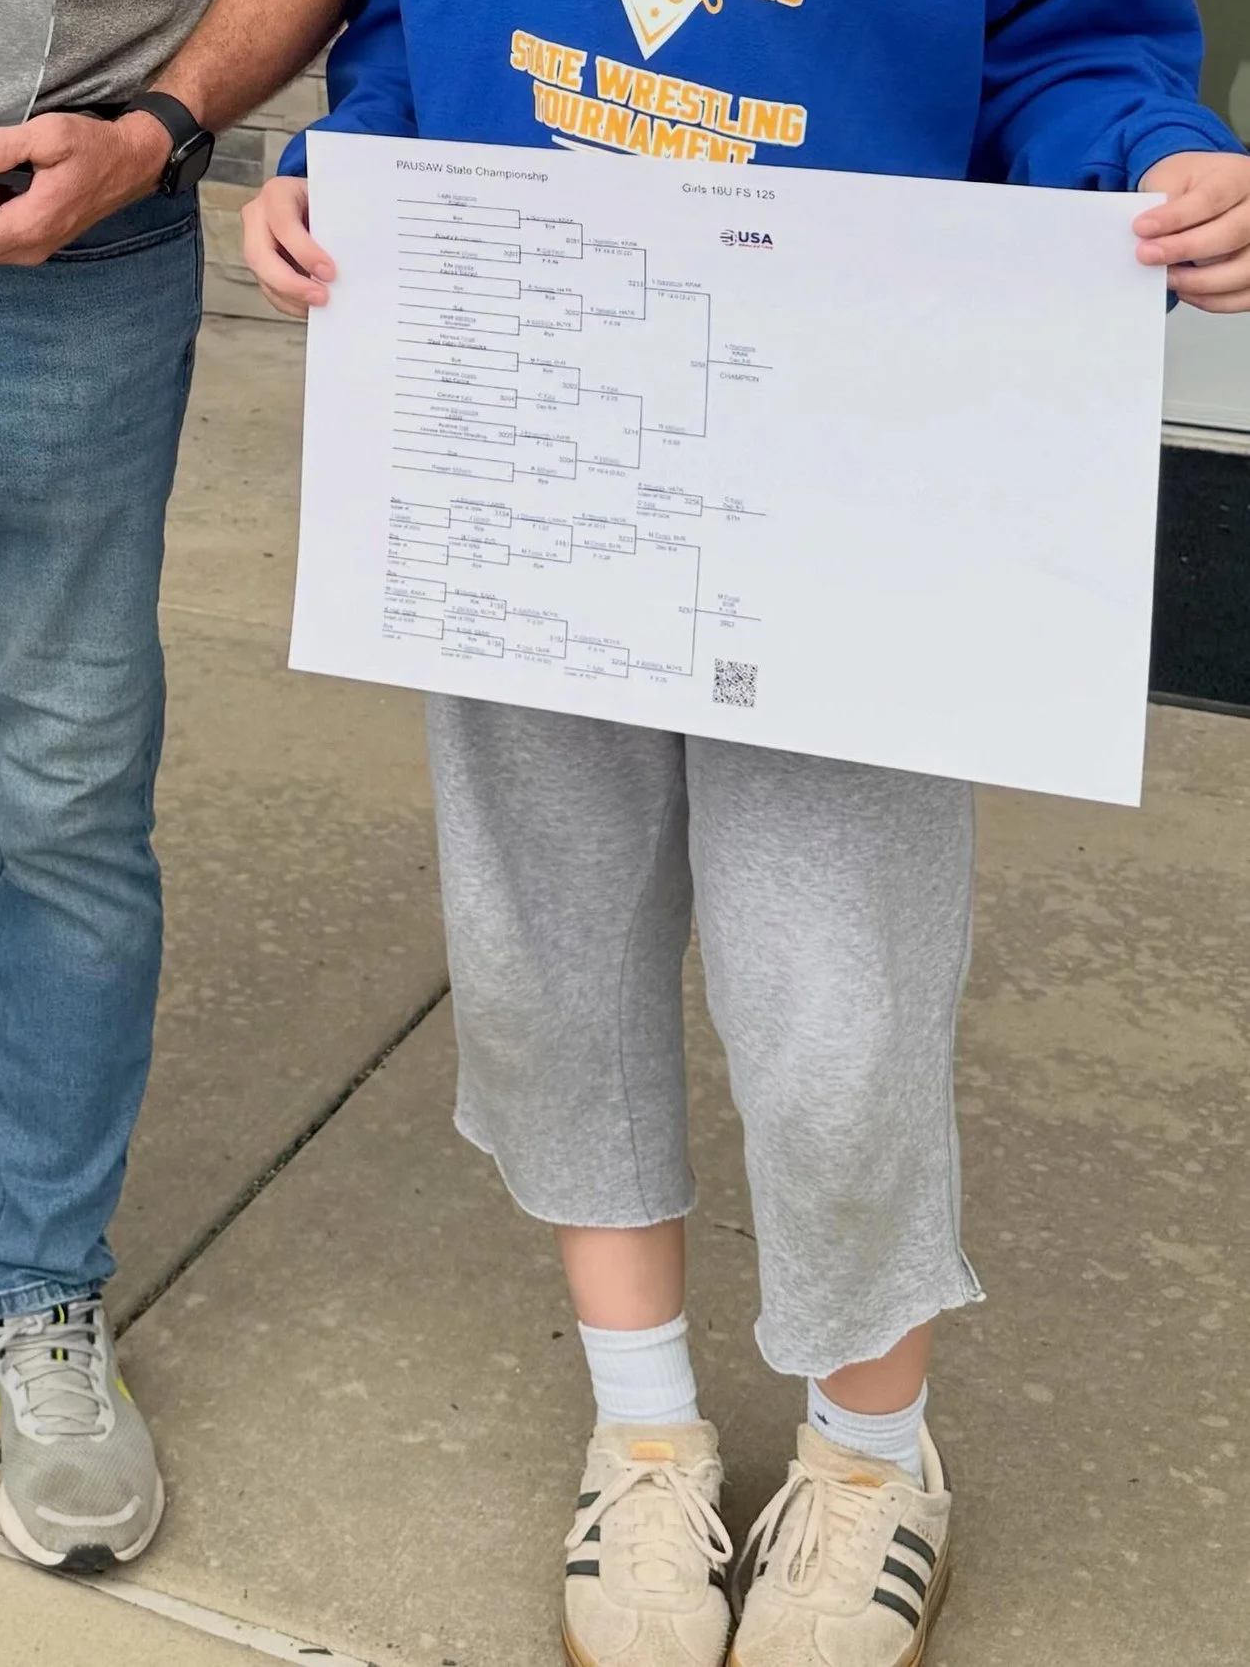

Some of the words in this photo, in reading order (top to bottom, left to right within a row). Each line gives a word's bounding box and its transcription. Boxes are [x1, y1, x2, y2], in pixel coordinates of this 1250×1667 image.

[510, 29, 588, 92] STATE
[595, 56, 807, 147] WRESTLING
[533, 80, 756, 164] TOURNAMENT
[396, 160, 443, 173] PAUSAW
[475, 166, 548, 182] Championship
[682, 183, 707, 194] Girls
[736, 188, 751, 198] FS
[756, 190, 775, 200] 125
[738, 231, 773, 245] USA
